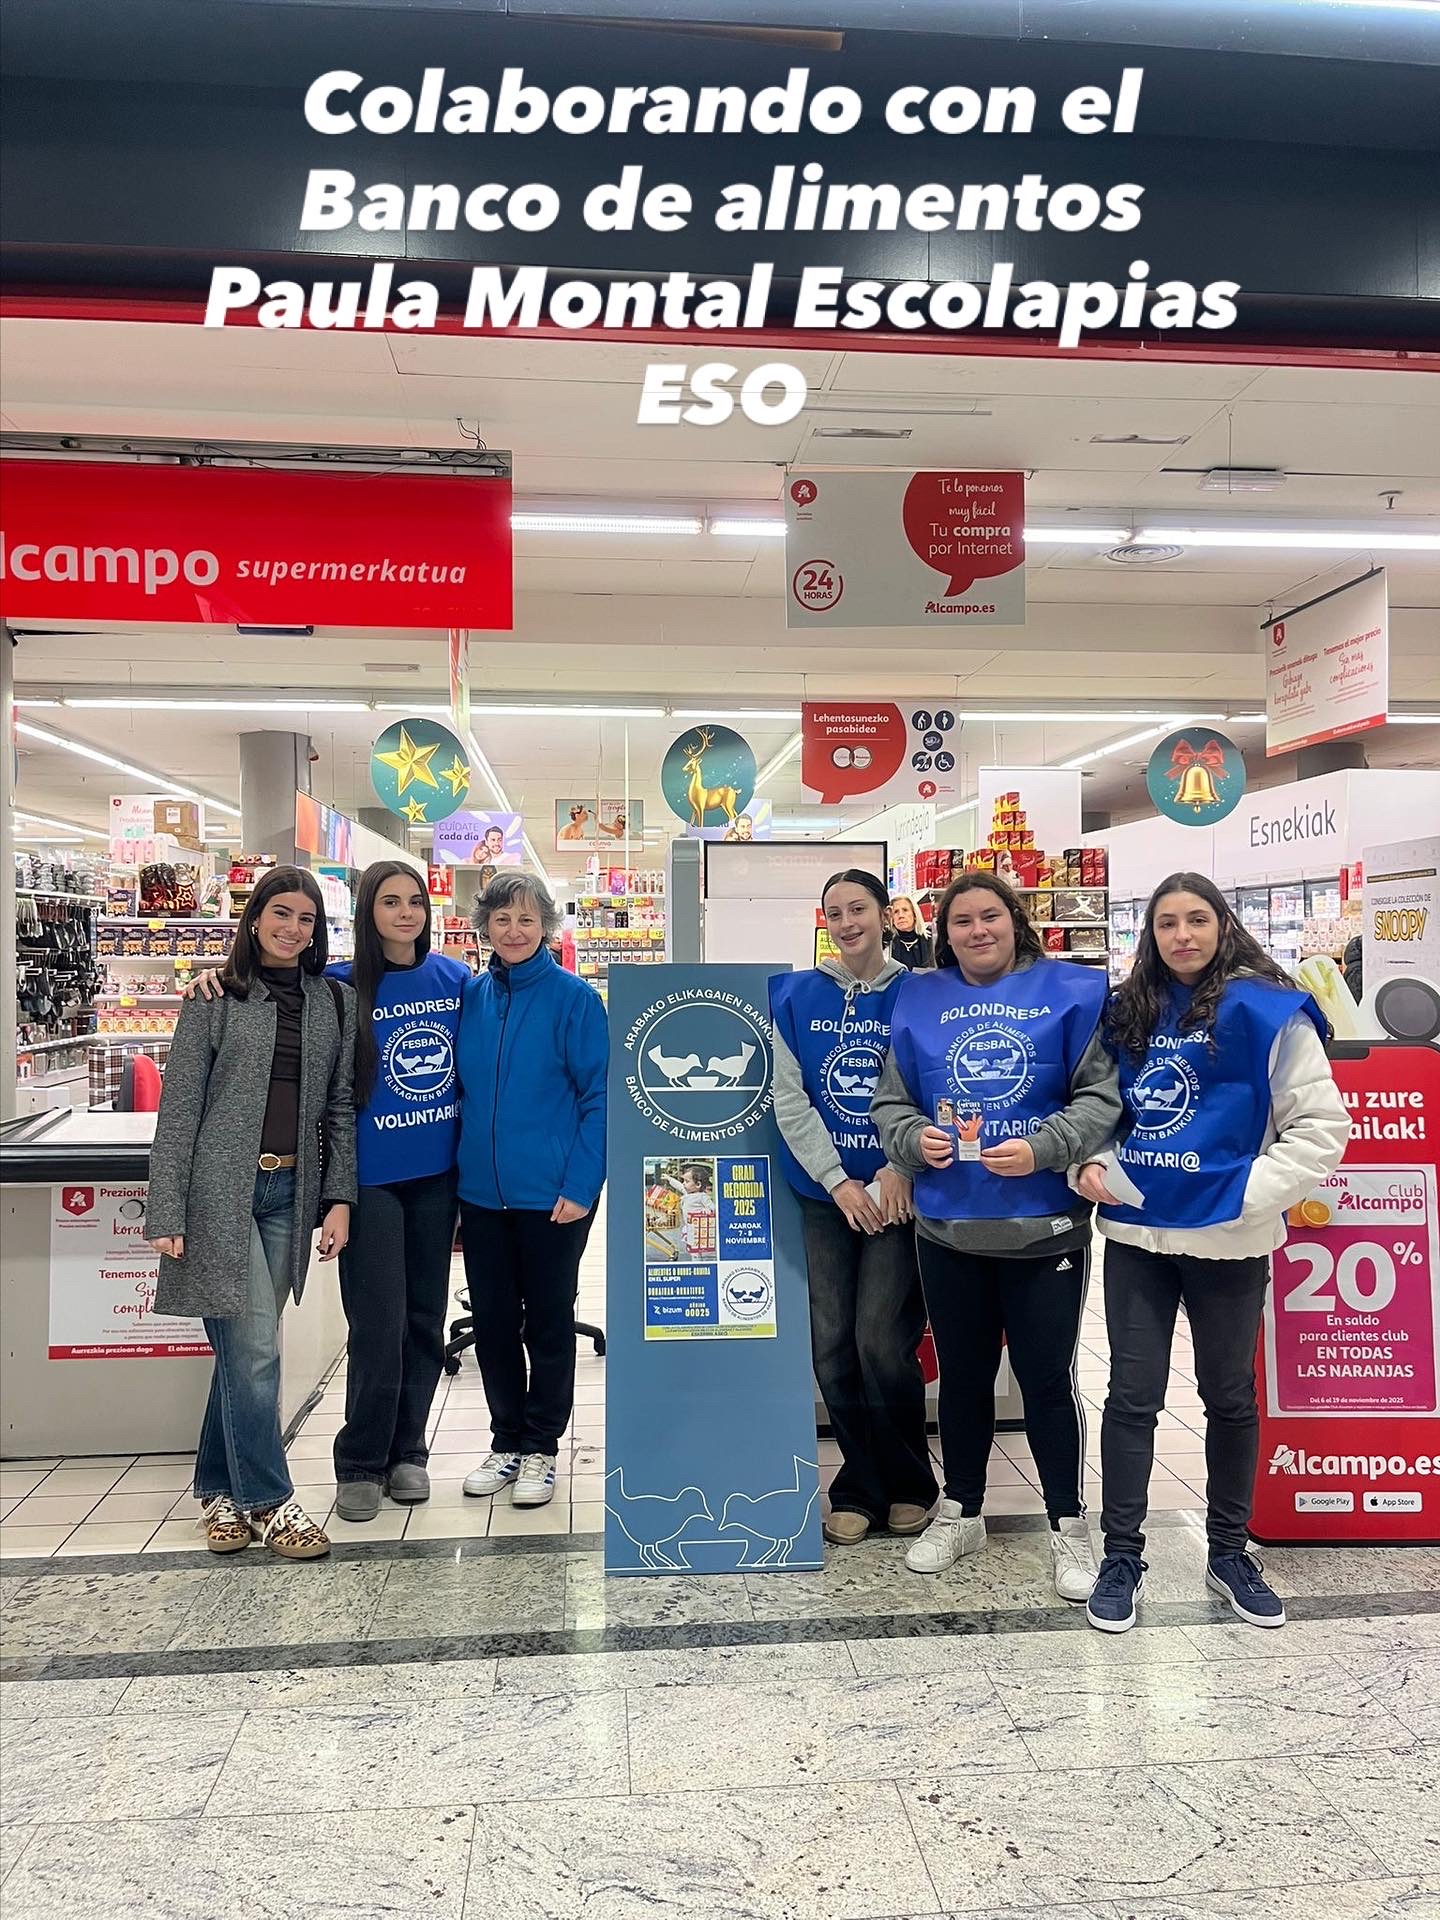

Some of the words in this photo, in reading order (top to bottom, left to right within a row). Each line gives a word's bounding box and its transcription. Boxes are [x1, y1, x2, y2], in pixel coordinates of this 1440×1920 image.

[937, 478, 952, 494] Te
[953, 477, 964, 493] lo
[965, 484, 1004, 498] ponemos
[949, 507, 970, 522] muy
[972, 501, 996, 519] fácil
[929, 523, 948, 537] Tu
[953, 524, 1012, 540] compra
[929, 543, 953, 558] por
[957, 541, 1013, 556] Internet
[236, 556, 467, 586] supermerkatua
[803, 569, 834, 591] 24
[804, 591, 833, 600] HORAS
[924, 601, 996, 615] Alcampo.es
[813, 713, 890, 723] Lehentasunezko
[826, 724, 877, 736] pasabidea
[1250, 799, 1337, 848] Esnekiak
[439, 832, 462, 841] cada
[464, 831, 479, 841] día
[1374, 906, 1428, 942] SNOOPY
[372, 997, 461, 1021] OLONDRESA
[940, 1002, 1052, 1025] BOLONDRESA
[624, 1000, 666, 1051] ARABAKO
[667, 988, 743, 1007] ELIKAGAIEN
[810, 1019, 892, 1036] BOLONDRE
[381, 1026, 405, 1062] BANCOS
[404, 1020, 418, 1030] DE
[402, 1036, 442, 1050] FESBAL
[945, 1026, 975, 1062] BANCOS
[976, 1021, 991, 1031] DE
[991, 1020, 1037, 1059] ALIMENTOS
[969, 1039, 1014, 1051] FESBAL
[819, 1041, 848, 1076] BANCOS
[849, 1038, 861, 1048] DE
[862, 1038, 888, 1056] ALIME
[1172, 1054, 1201, 1092] MENTOS
[384, 1074, 435, 1102] ELIKAGAIEN
[1002, 1074, 1036, 1108] BANKUA
[625, 1075, 653, 1117] BANCO
[651, 1113, 670, 1132] DE
[669, 1122, 746, 1142] ALIMENTOS
[745, 1107, 763, 1128] DE
[820, 1089, 869, 1126] ELIKAGAIEN
[1365, 1091, 1425, 1109] zure
[1159, 1108, 1197, 1140] BANKUA
[832, 1131, 883, 1150] LUNTA
[731, 1164, 755, 1181] GRAN
[99, 1188, 148, 1198] Preziorik
[723, 1181, 765, 1199] RECOGIDA
[1388, 1184, 1424, 1198] Club
[733, 1199, 756, 1216] 2025
[1337, 1191, 1424, 1213] Alcampo
[728, 1222, 762, 1230] AZAROAK
[725, 1236, 767, 1245] NOVIEMBRE
[99, 1269, 147, 1279] Tenemos
[149, 1268, 158, 1278] el
[662, 1305, 683, 1314] bizum
[684, 1308, 711, 1318] 00025
[1326, 1314, 1342, 1326] En
[1344, 1314, 1380, 1327] saldo
[1299, 1331, 1329, 1344] para
[1330, 1329, 1379, 1342] clientes
[1381, 1329, 1409, 1342] club
[1316, 1346, 1337, 1360] EN
[1339, 1346, 1393, 1360] TODAS
[1297, 1364, 1327, 1378] LAS
[1329, 1364, 1414, 1378] NARANJAS
[1268, 1444, 1440, 1480] Alcampo.es
[1311, 1497, 1336, 1508] Google
[1335, 1497, 1350, 1508] Play
[1382, 1497, 1397, 1508] App
[1397, 1497, 1415, 1506] Store
